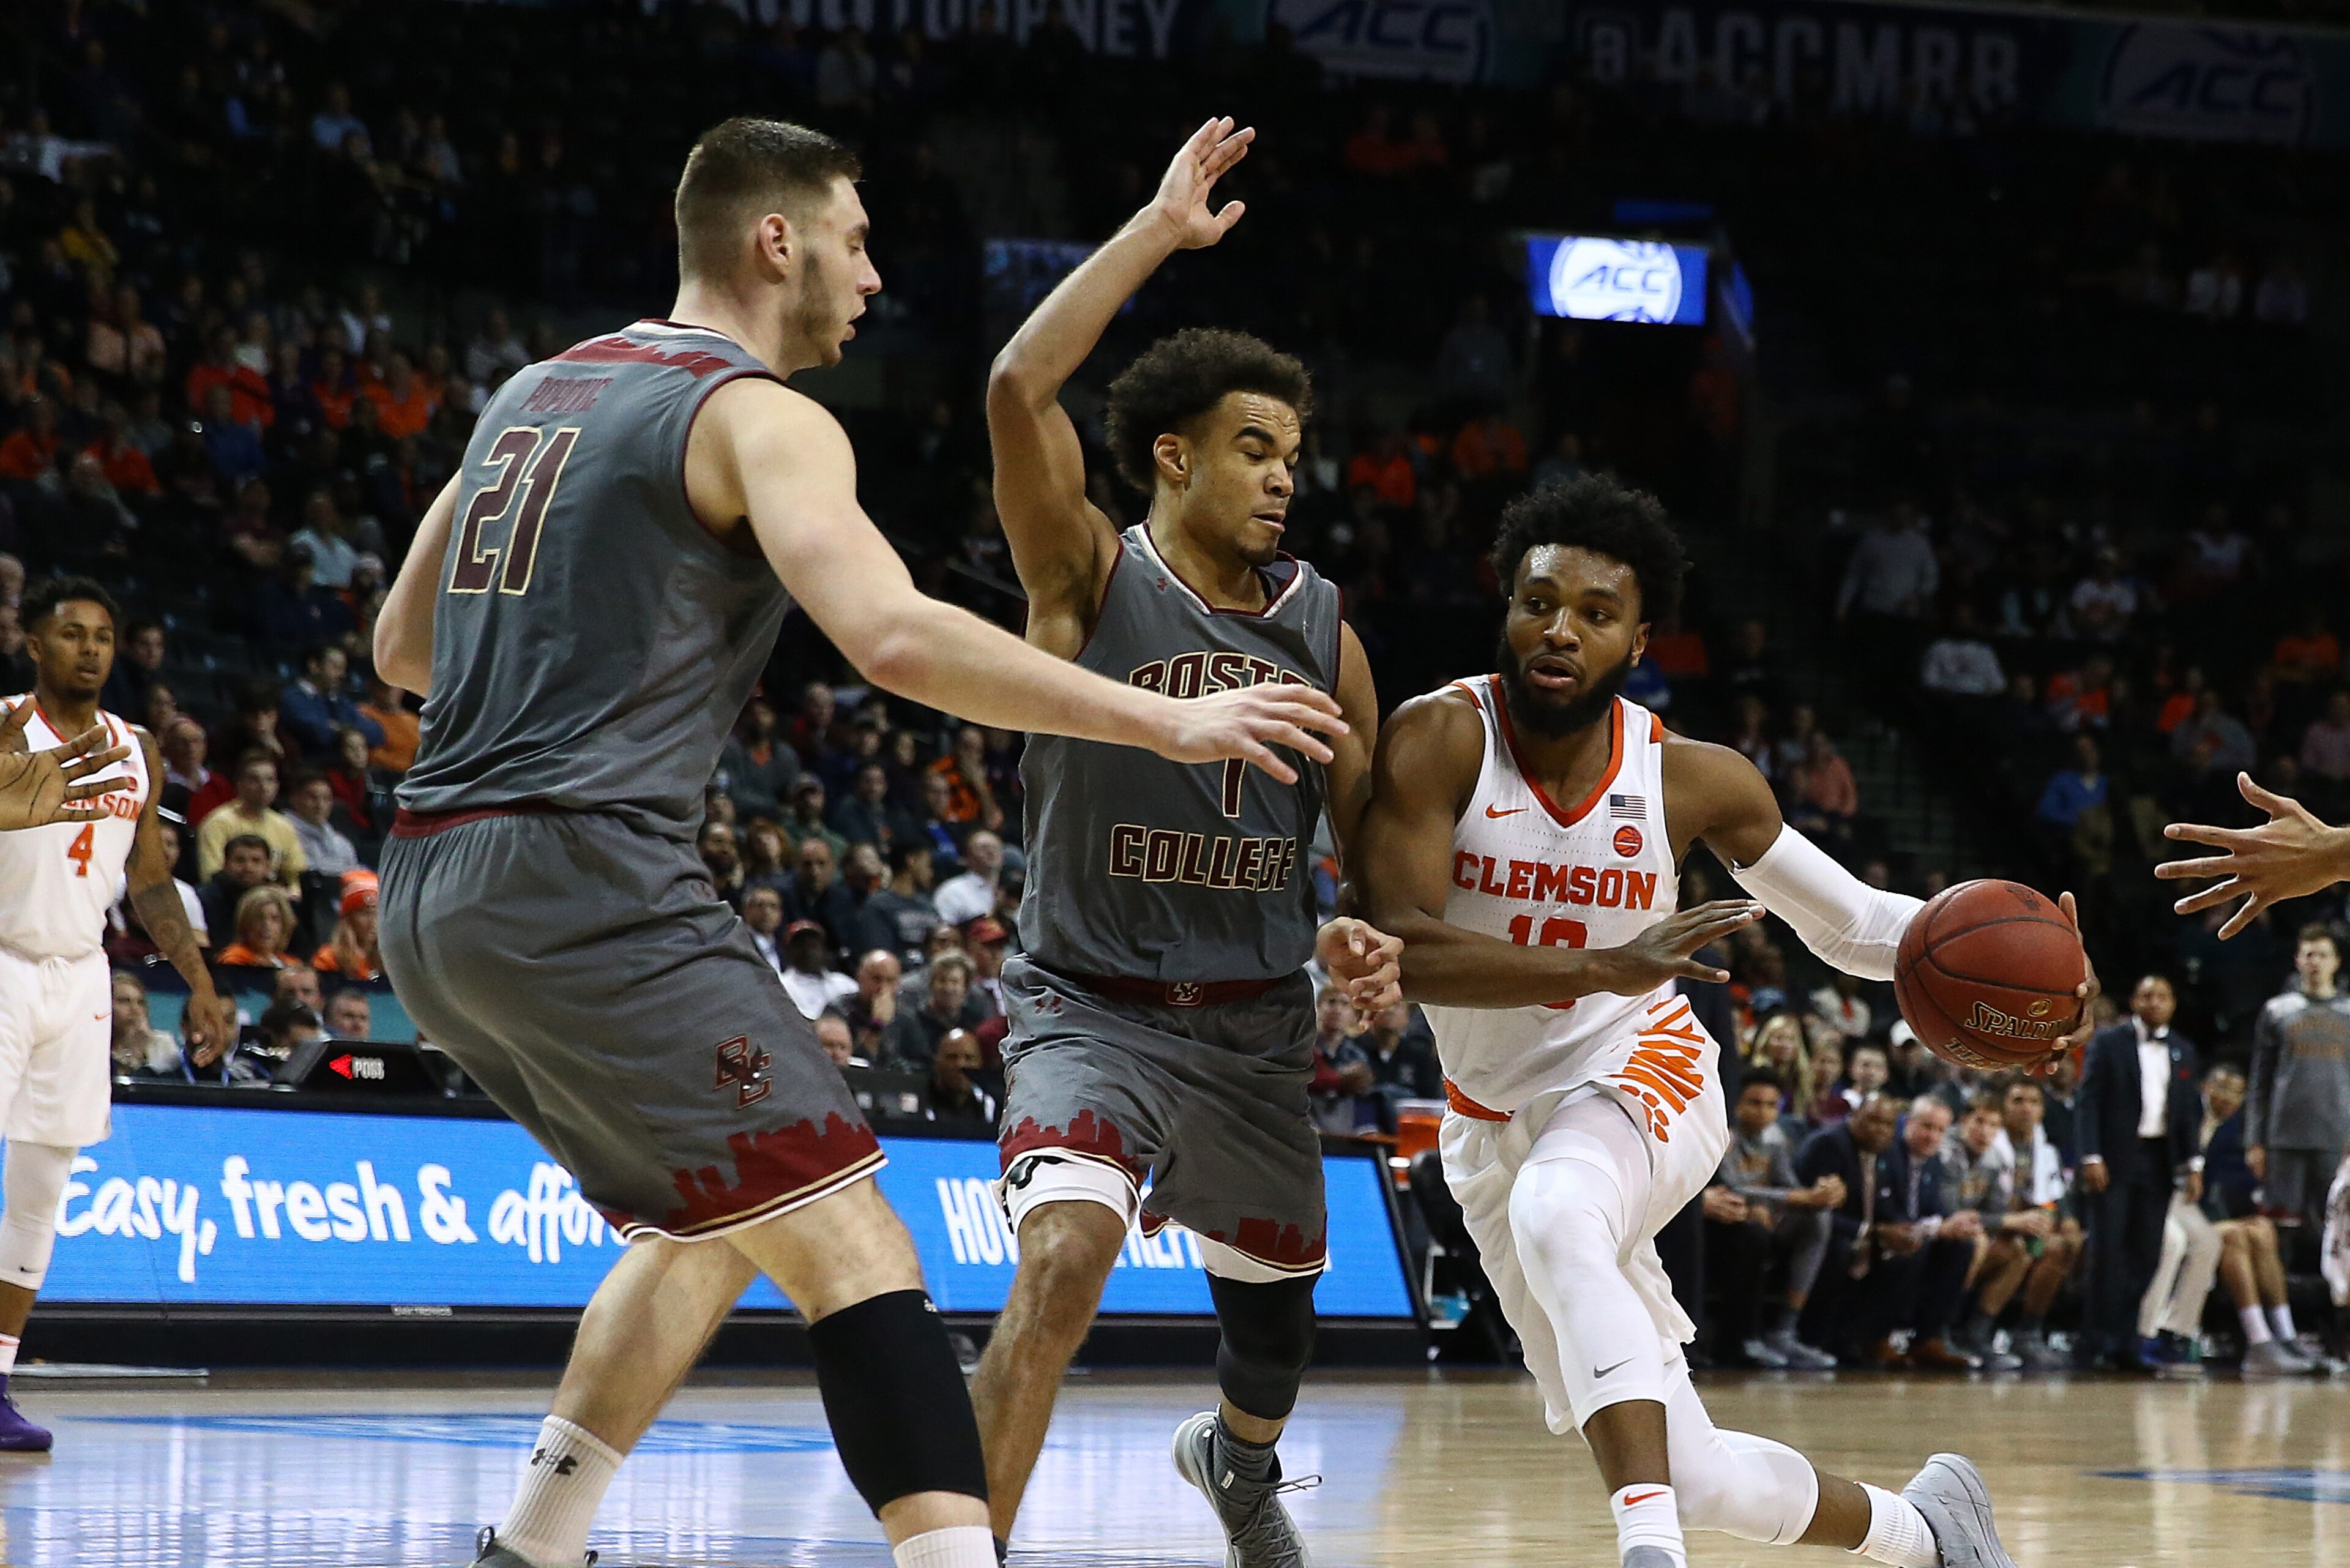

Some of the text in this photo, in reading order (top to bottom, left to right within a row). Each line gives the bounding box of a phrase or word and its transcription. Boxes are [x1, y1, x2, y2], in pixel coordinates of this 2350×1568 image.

[1572, 265, 1674, 294] ACC
[447, 426, 582, 596] 21
[67, 823, 95, 877] 4
[1109, 824, 1296, 892] COLLEGE
[1452, 849, 1657, 911] CLEMSON
[220, 1154, 412, 1242] fresh
[417, 1163, 479, 1245] &
